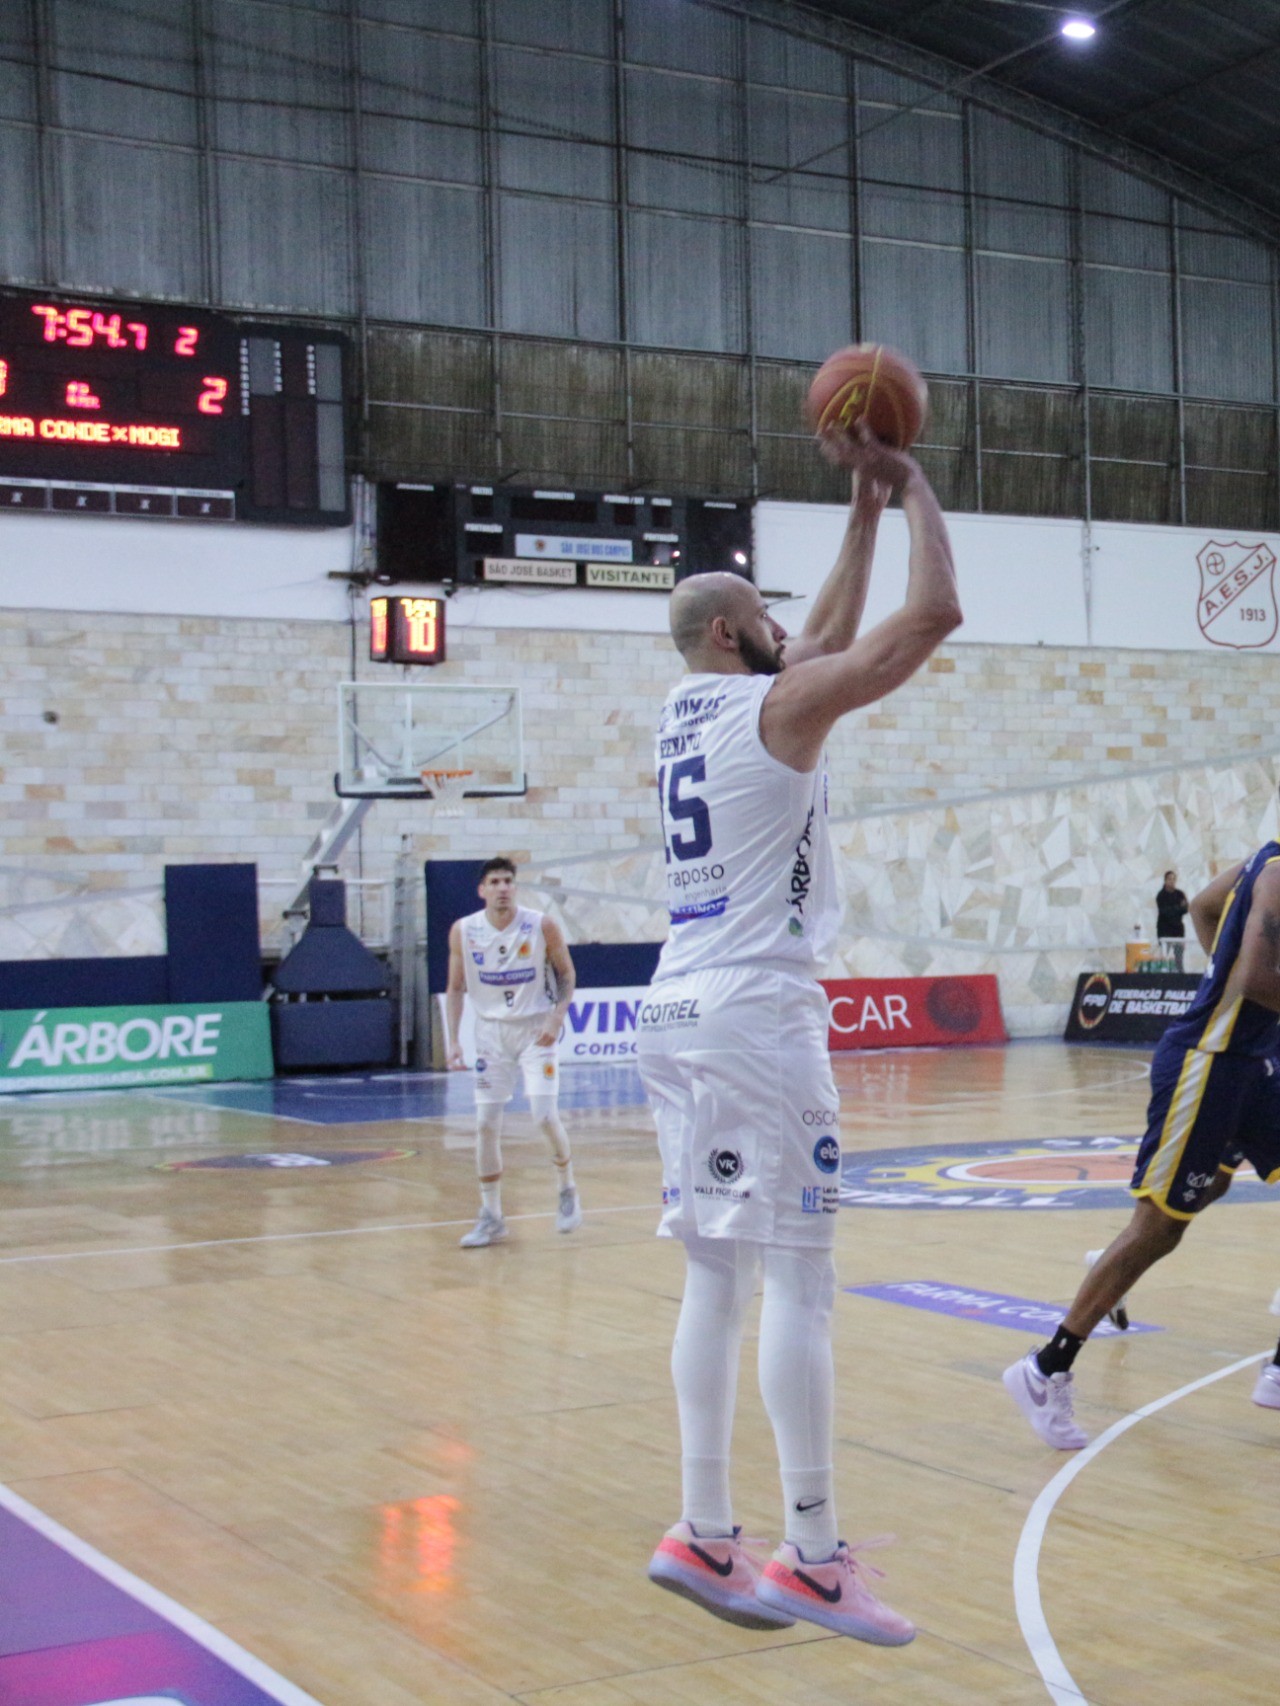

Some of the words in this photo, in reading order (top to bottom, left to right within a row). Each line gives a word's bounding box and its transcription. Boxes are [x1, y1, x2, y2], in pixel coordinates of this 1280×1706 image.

[174, 326, 199, 356] 2
[197, 376, 228, 415] 2
[488, 562, 508, 576] SÃO
[536, 566, 573, 580] BASKET
[589, 569, 670, 586] VISITANTE
[1239, 607, 1267, 622] 1913
[407, 617, 437, 653] 10
[667, 863, 725, 892] raposo
[1113, 987, 1162, 1000] FEDERAÇÃO
[641, 998, 701, 1024] COTREL
[828, 994, 912, 1034] CAR
[1108, 1001, 1124, 1014] DE
[1125, 1001, 1191, 1016] BASKETBA
[8, 1010, 223, 1069] ÁRBORE
[820, 1142, 839, 1160] elo
[694, 1185, 714, 1196] VALE
